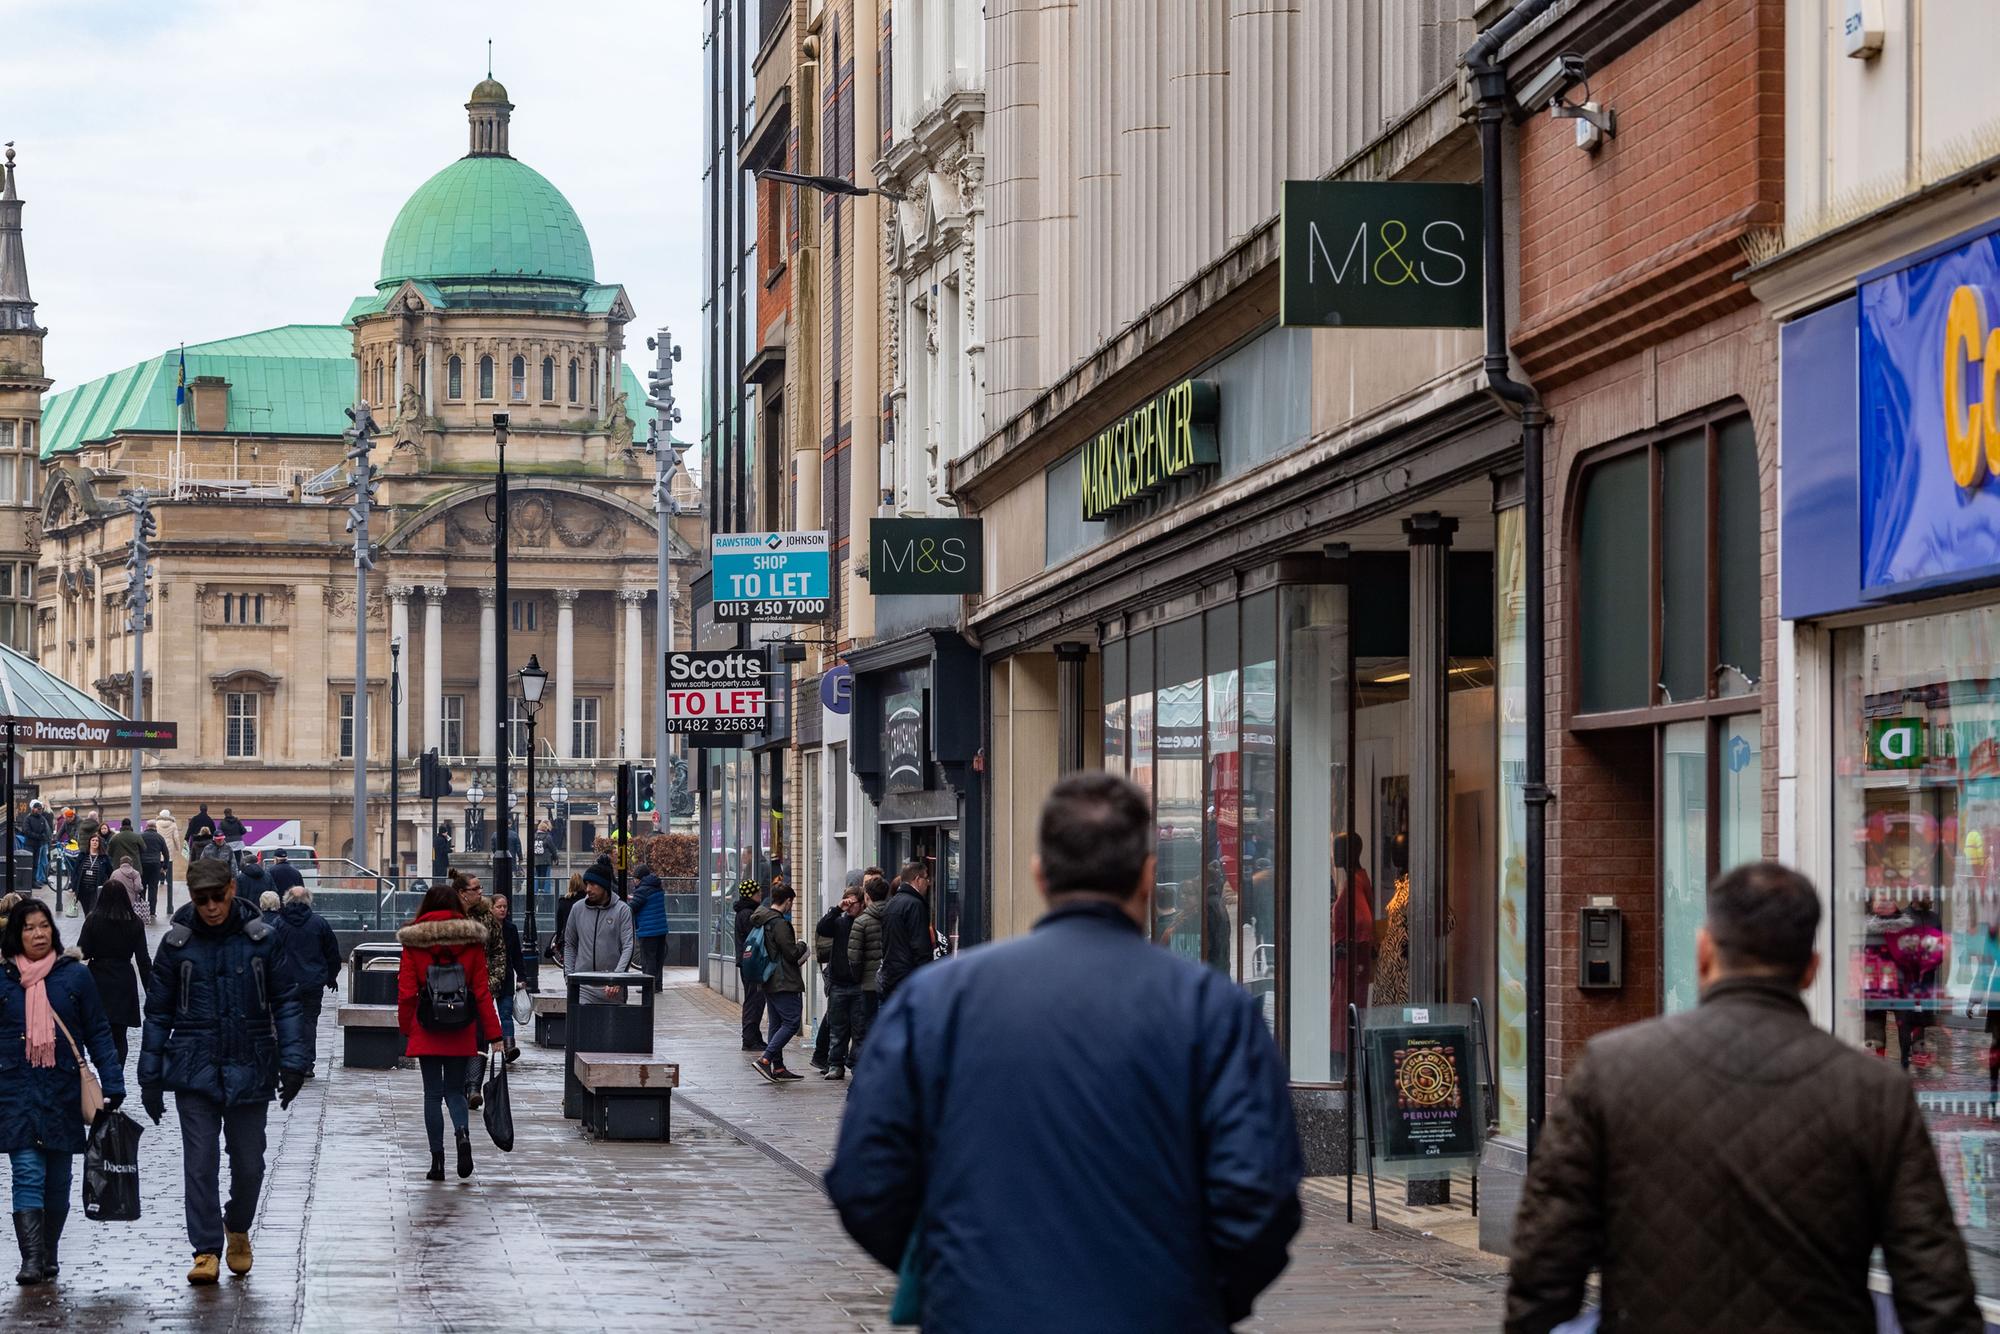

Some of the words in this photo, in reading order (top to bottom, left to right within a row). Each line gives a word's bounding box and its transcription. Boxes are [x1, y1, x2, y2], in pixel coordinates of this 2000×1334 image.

[1309, 220, 1466, 286] M&S
[1081, 379, 1194, 519] MARKS&SPENCER
[716, 537, 762, 547] RAWSTRON
[786, 535, 824, 547] JOHNSON
[753, 555, 787, 570] SHOP
[882, 538, 966, 573] M&S
[730, 574, 761, 597] TO
[769, 572, 811, 596] LET
[719, 602, 749, 616] 0113
[754, 602, 782, 614] 450
[787, 600, 824, 614] 7000
[670, 653, 761, 680] Scotts
[671, 680, 760, 688] www.scotts-property.co.uk
[669, 692, 705, 715] TO
[715, 691, 763, 714] LET
[22, 725, 33, 736] TO
[667, 720, 709, 731] 01482
[714, 719, 765, 730] 325634
[1403, 1110, 1457, 1120] PERUVIAN
